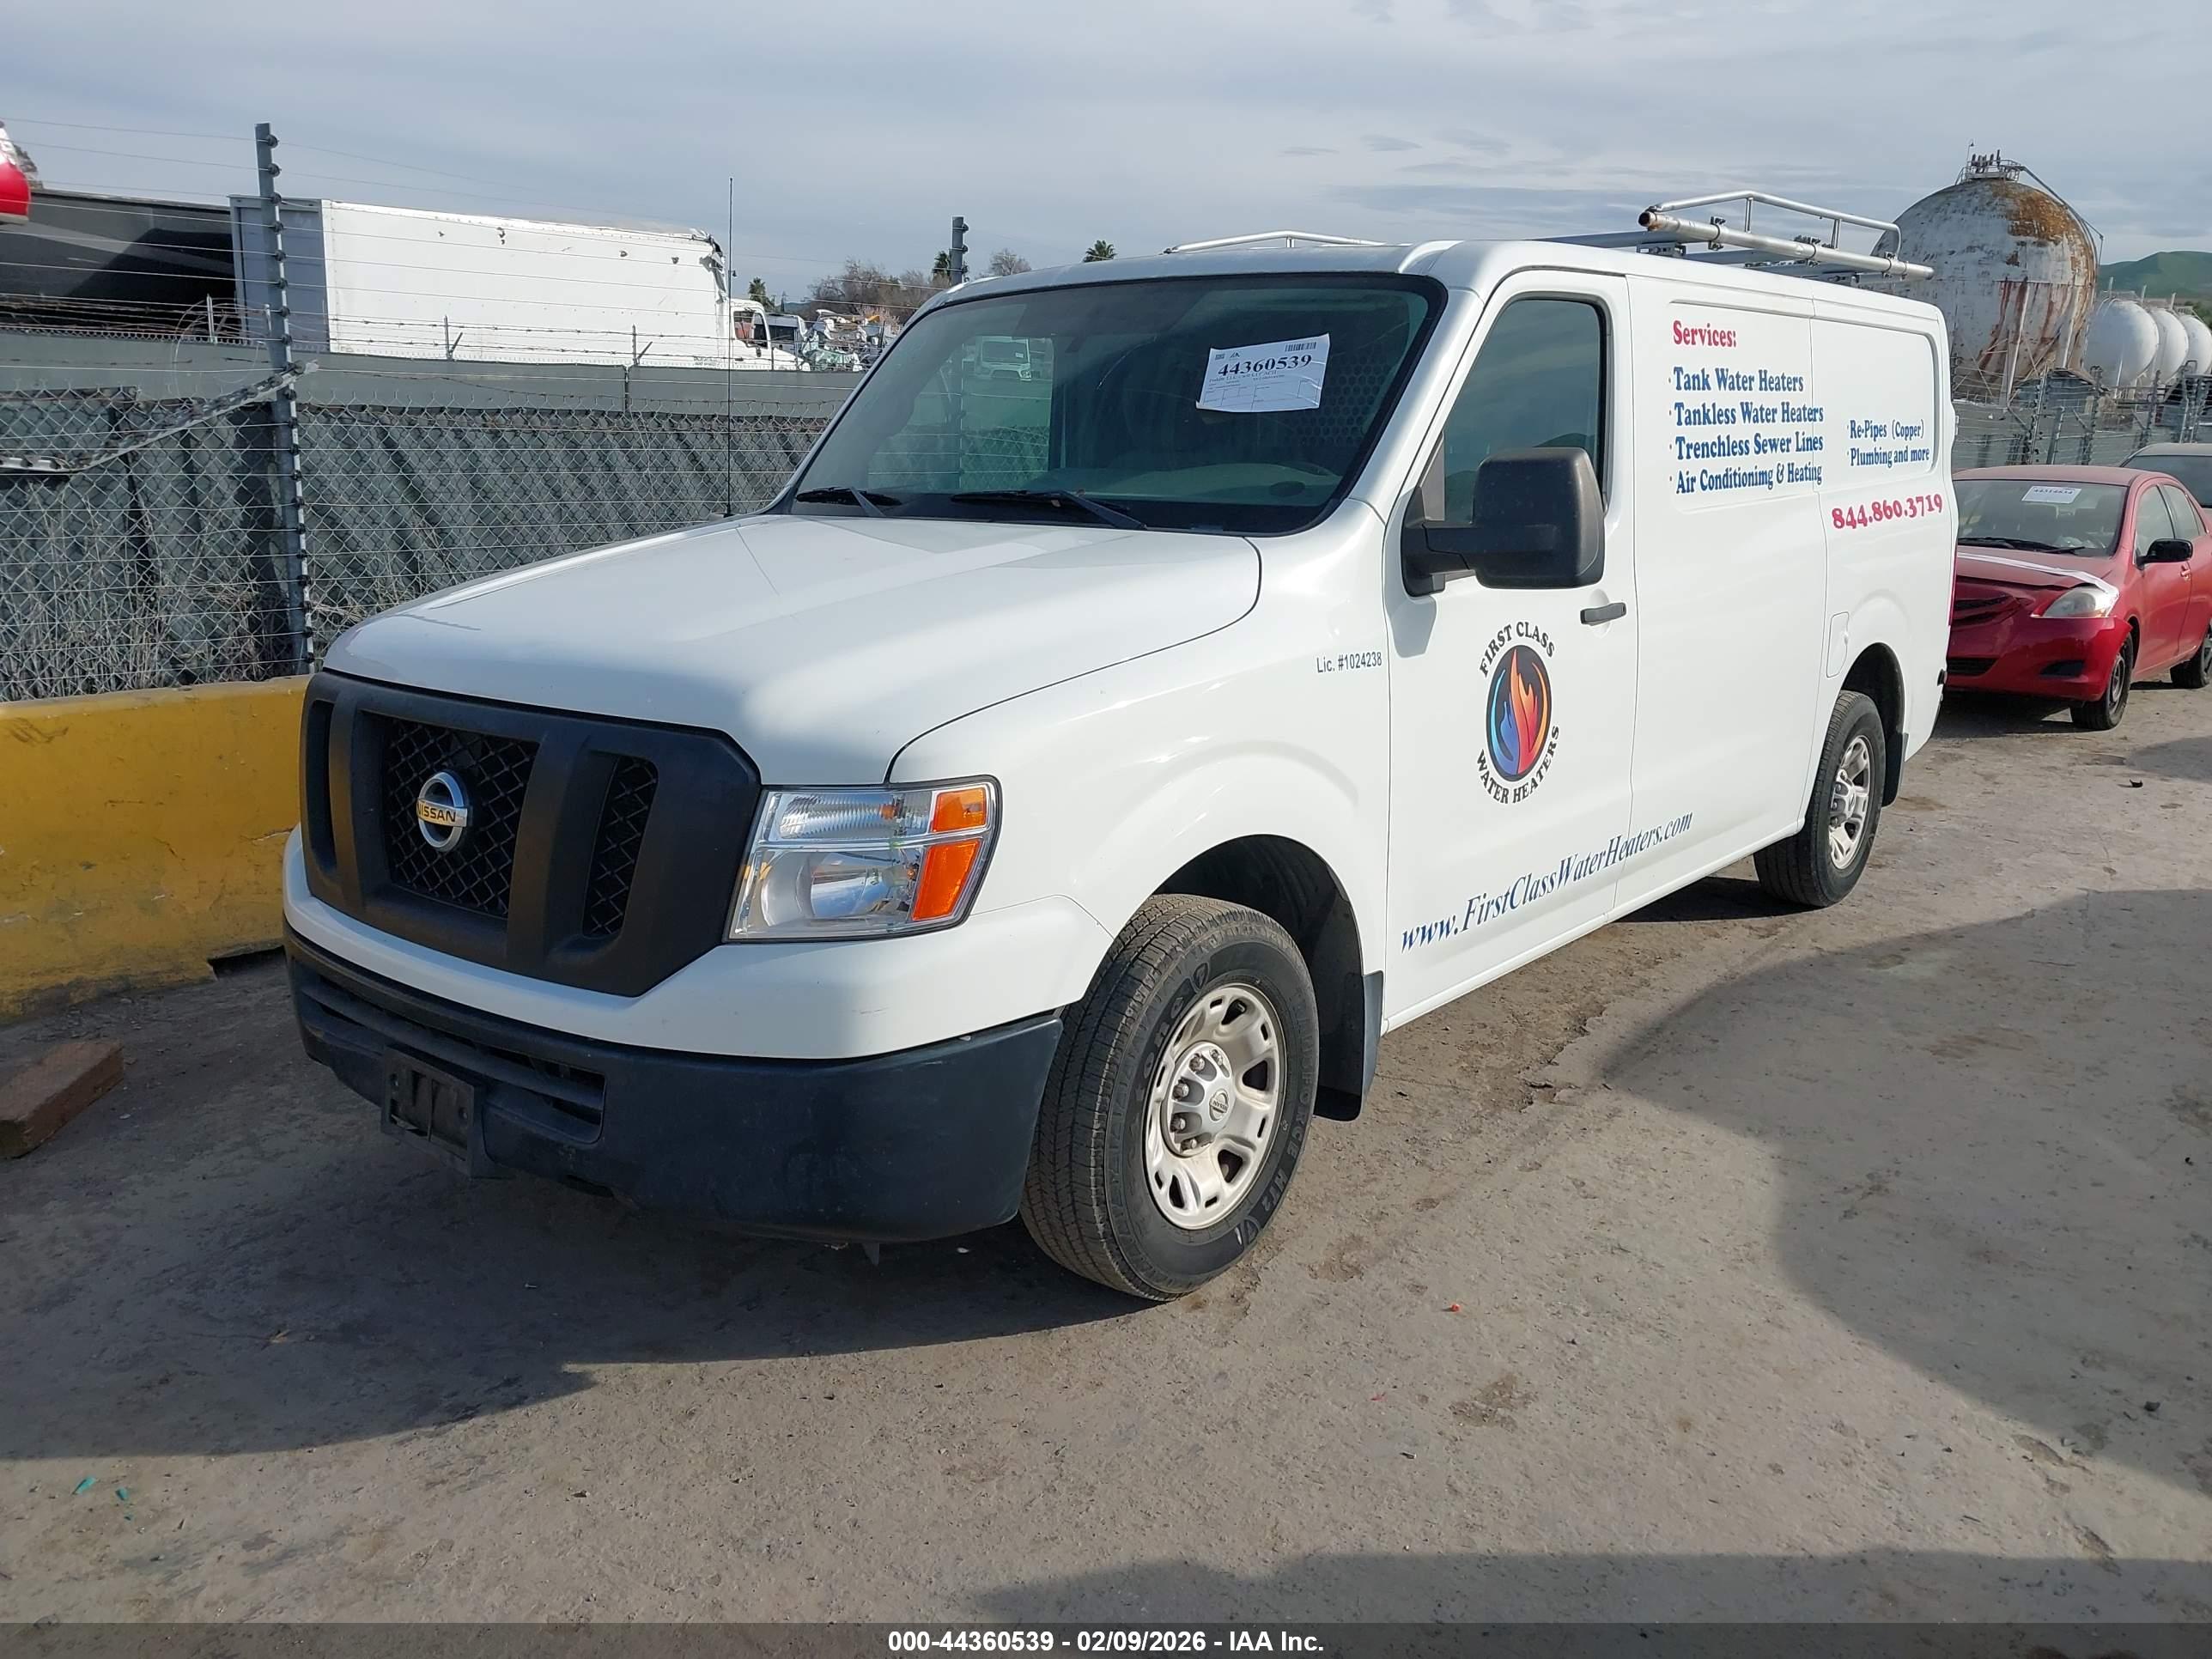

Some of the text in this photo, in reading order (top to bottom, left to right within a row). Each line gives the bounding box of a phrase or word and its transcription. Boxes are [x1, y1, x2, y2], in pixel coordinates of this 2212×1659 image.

[1673, 320, 1736, 348] Services:
[1218, 354, 1312, 377] 44360539
[1673, 367, 1804, 392] Tank Water Heaters
[1674, 401, 1824, 427] Tankless Water Heaters
[1850, 418, 1924, 442] Re-Pipes (Copper)
[1675, 430, 1824, 460] Trenchless Sewer Lines
[1850, 445, 1929, 468] Plumbing and more
[1675, 471, 1697, 495] Air
[1776, 462, 1785, 484] &
[1787, 461, 1822, 486] Heating
[1832, 494, 1943, 530] 844.860.3719
[1316, 651, 1382, 674] Lic. #1024238
[1479, 621, 1555, 678] FIRST CLASS
[1476, 725, 1559, 805] WATER HEATERS
[416, 803, 457, 823] NISSAN
